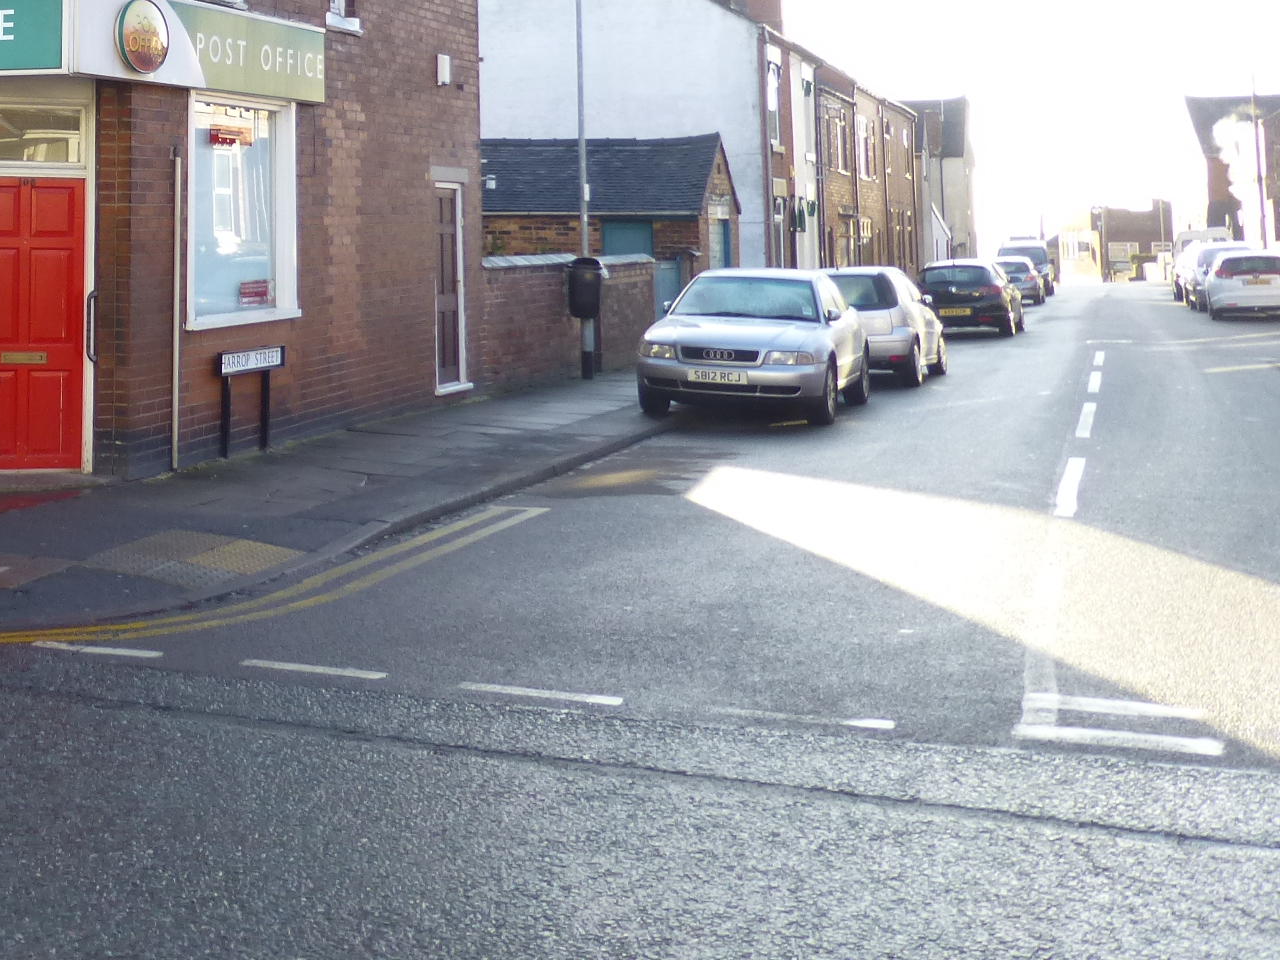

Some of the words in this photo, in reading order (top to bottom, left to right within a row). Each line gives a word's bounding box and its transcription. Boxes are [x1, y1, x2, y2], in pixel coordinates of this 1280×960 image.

[196, 32, 247, 67] POST
[260, 44, 324, 79] OFFICE
[255, 350, 280, 366] STREET
[719, 371, 741, 382] RCJ
